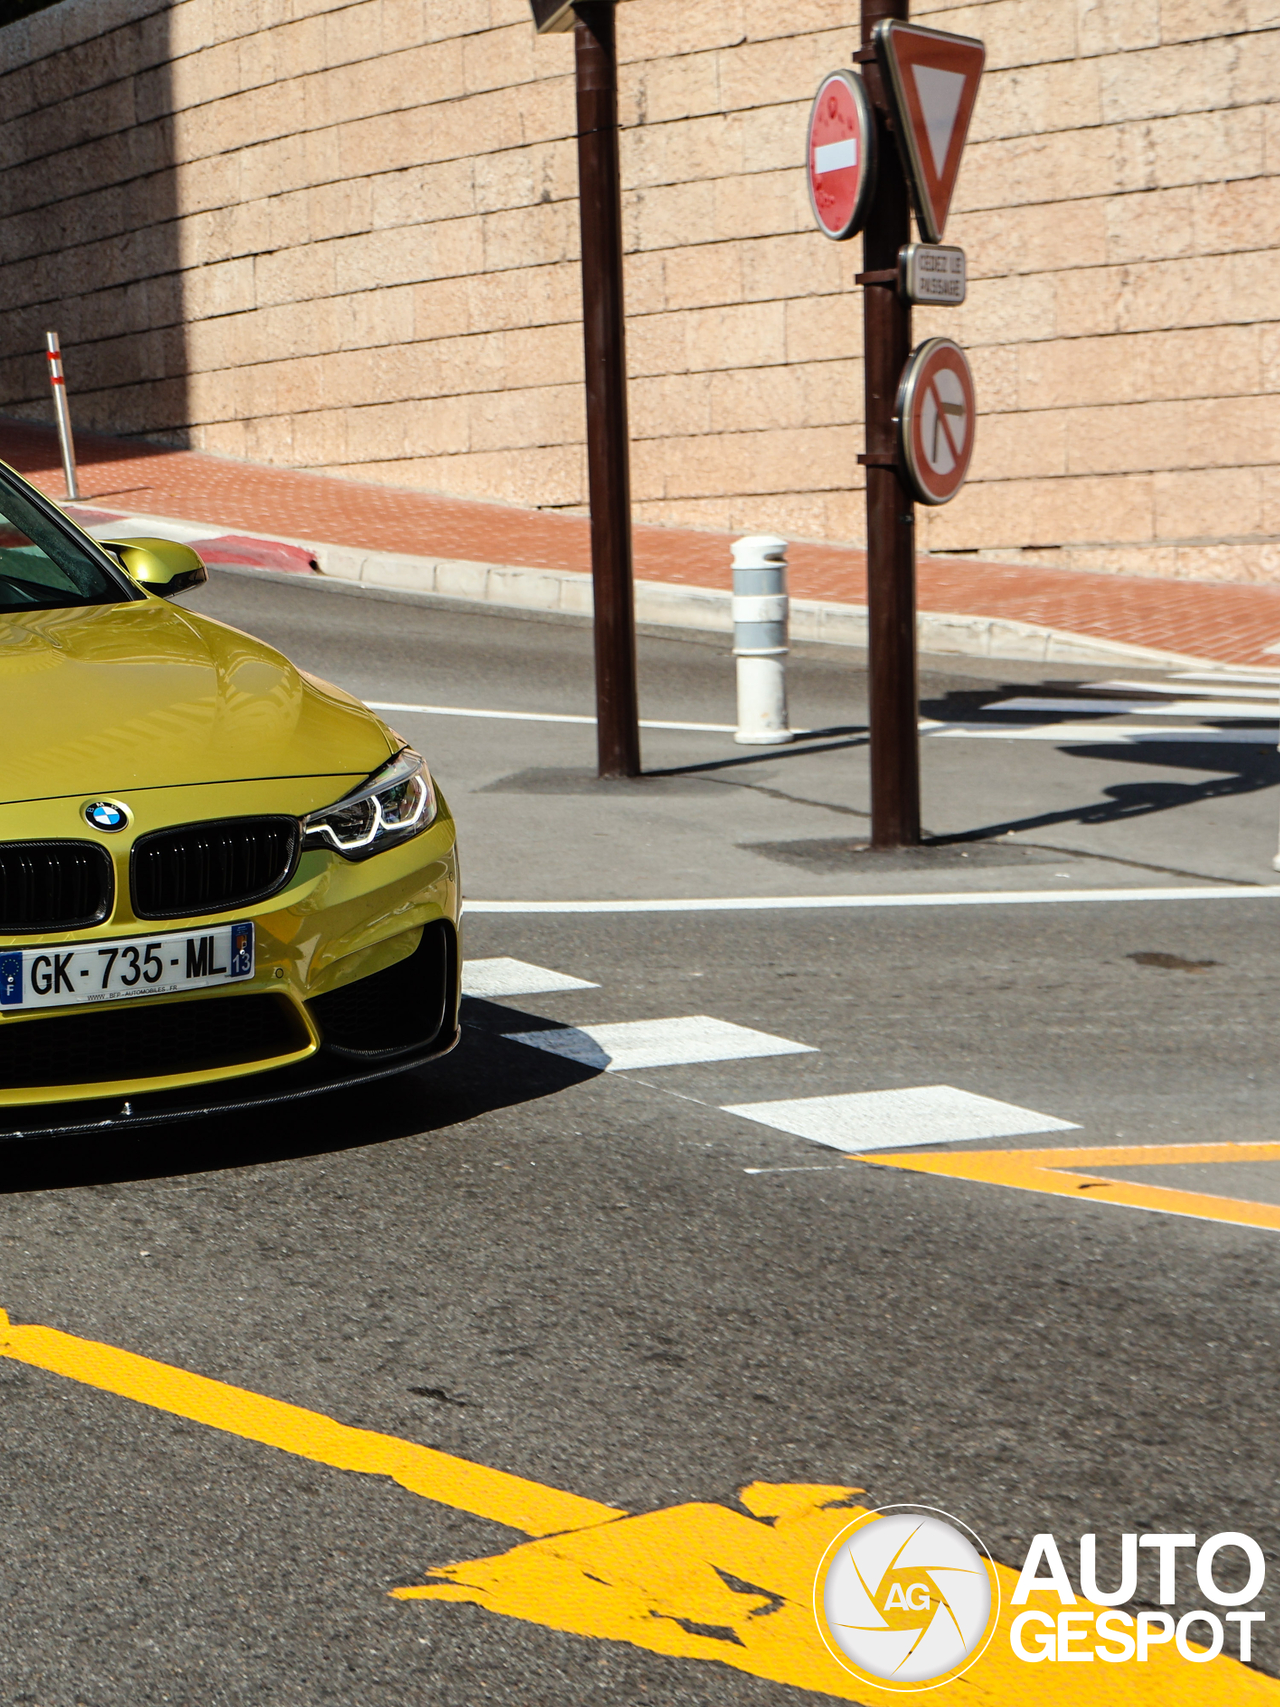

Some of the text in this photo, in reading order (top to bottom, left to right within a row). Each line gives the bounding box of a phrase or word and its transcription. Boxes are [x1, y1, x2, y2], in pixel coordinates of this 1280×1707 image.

[950, 257, 962, 275] LE
[920, 277, 960, 297] PASSAGE
[233, 952, 251, 973] 13
[6, 984, 15, 997] F
